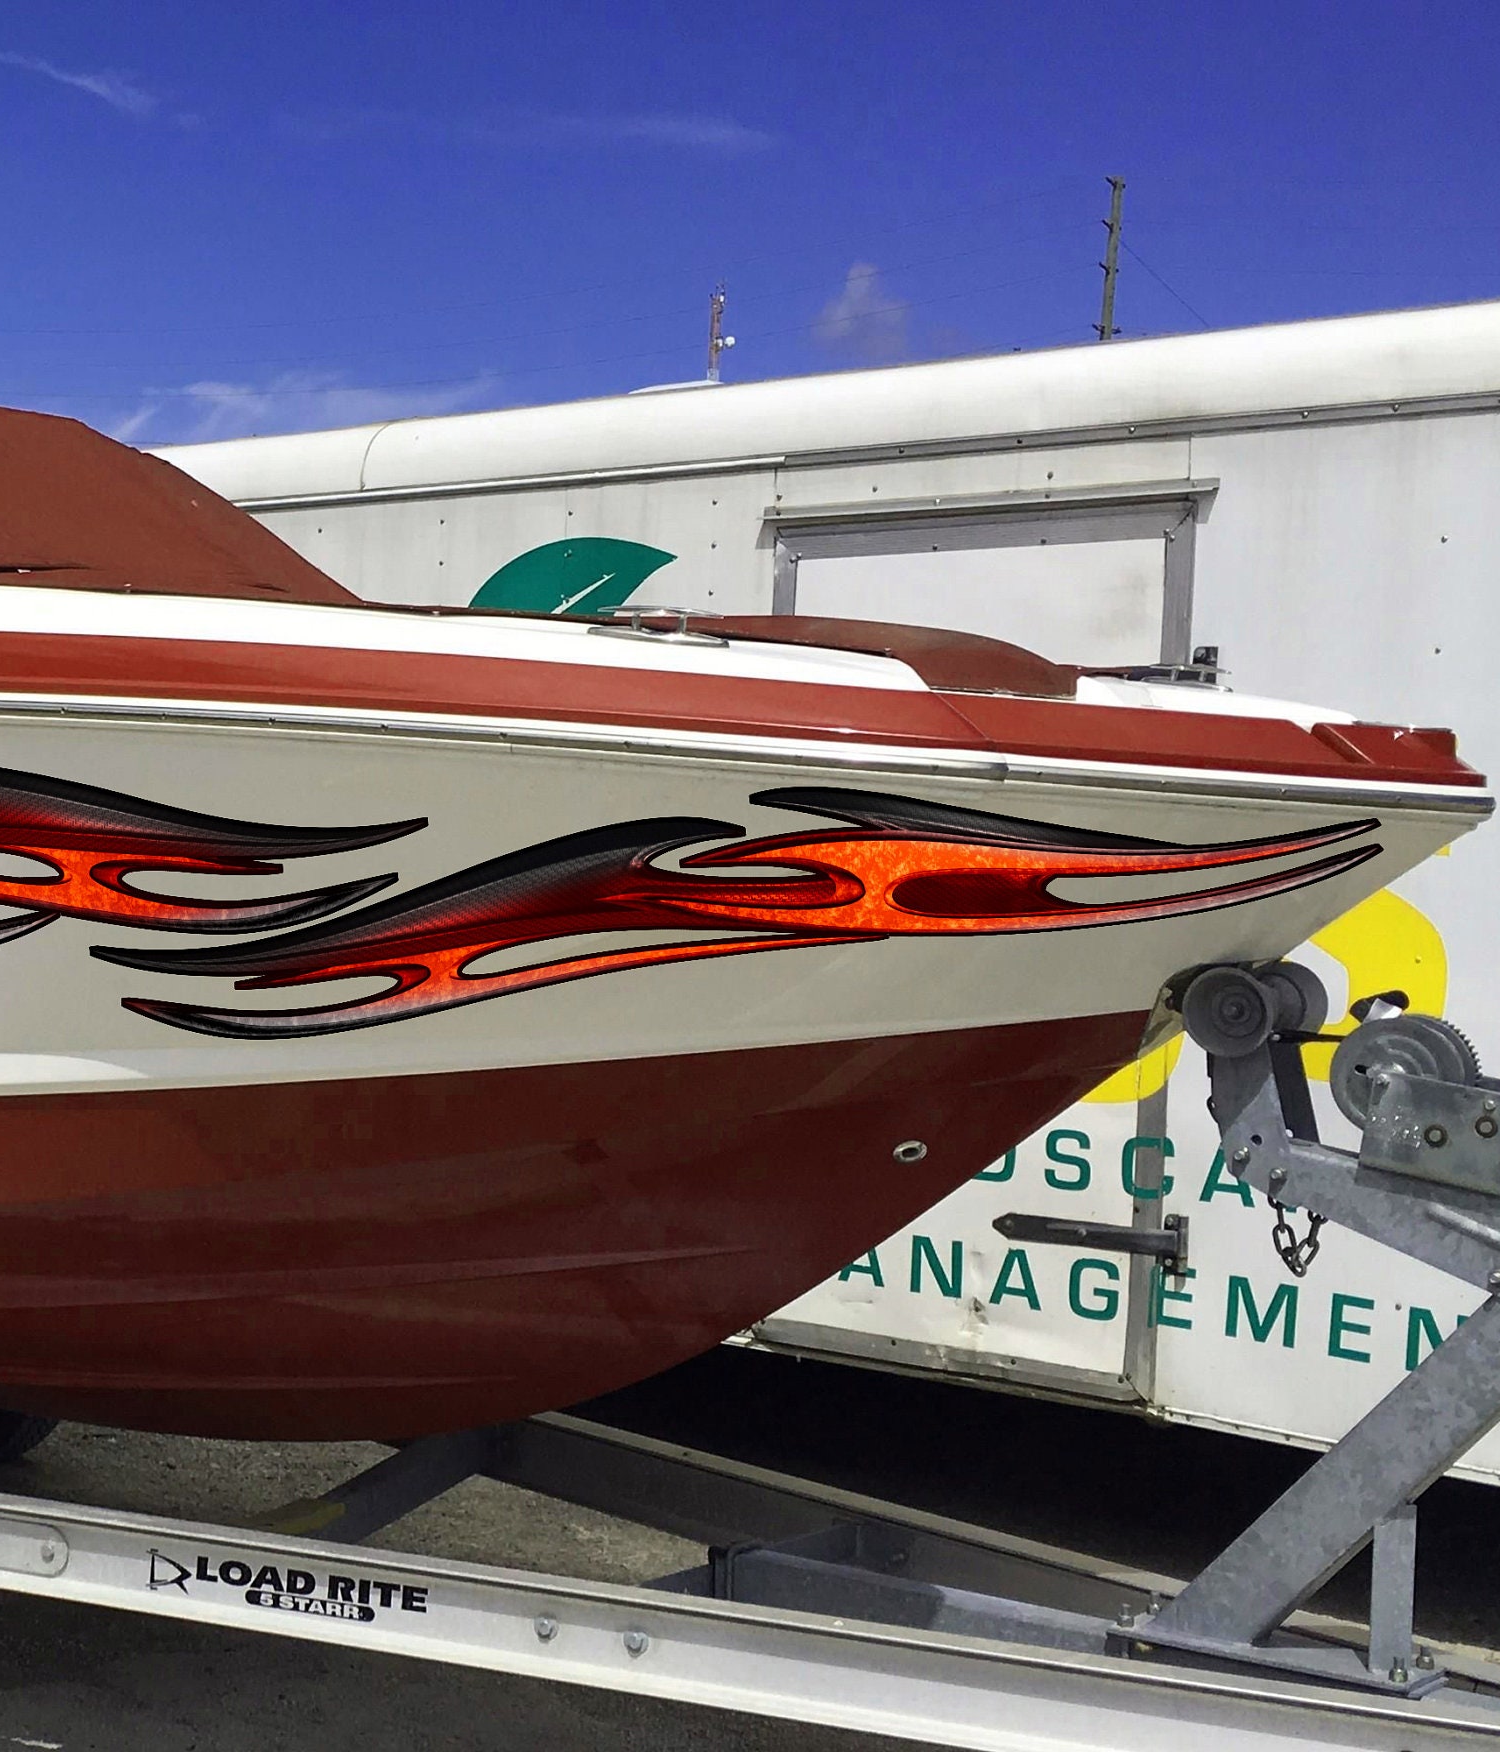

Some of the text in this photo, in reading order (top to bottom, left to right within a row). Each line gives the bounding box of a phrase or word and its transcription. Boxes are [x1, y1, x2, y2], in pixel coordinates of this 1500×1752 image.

[195, 1556, 429, 1613] LOAD RITE
[260, 1593, 360, 1620] 5 STARR
